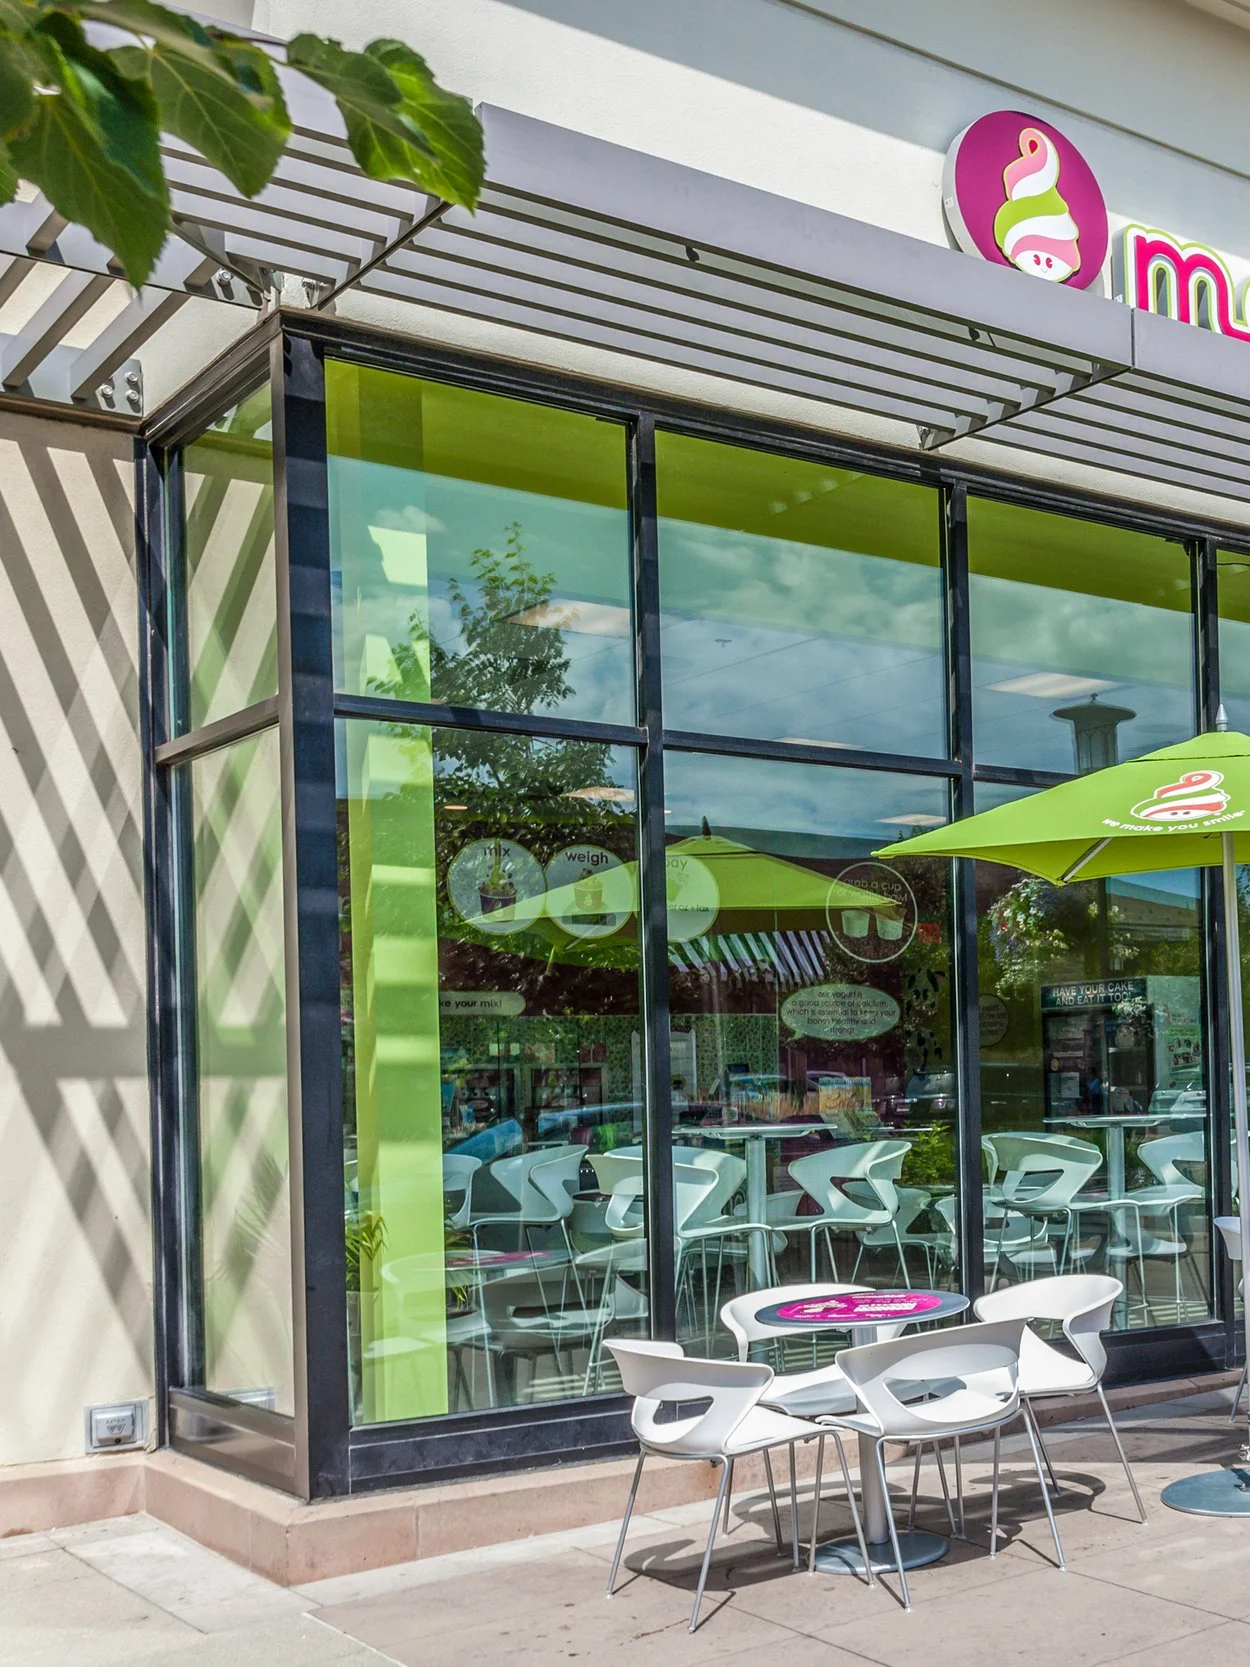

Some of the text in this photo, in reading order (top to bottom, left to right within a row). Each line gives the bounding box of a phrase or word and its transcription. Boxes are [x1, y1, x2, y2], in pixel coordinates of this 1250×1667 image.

[1102, 811, 1244, 832] we make you smile
[566, 851, 609, 865] weigh
[881, 882, 902, 892] cup
[1052, 981, 1134, 997] HAVE YOUR CAKE
[833, 991, 856, 999] yogurt
[1056, 996, 1075, 1006] AND
[1077, 994, 1096, 1005] EAT
[1096, 993, 1106, 1003] IT
[454, 1000, 477, 1009] your
[480, 999, 503, 1008] mix!
[880, 1010, 896, 1018] your
